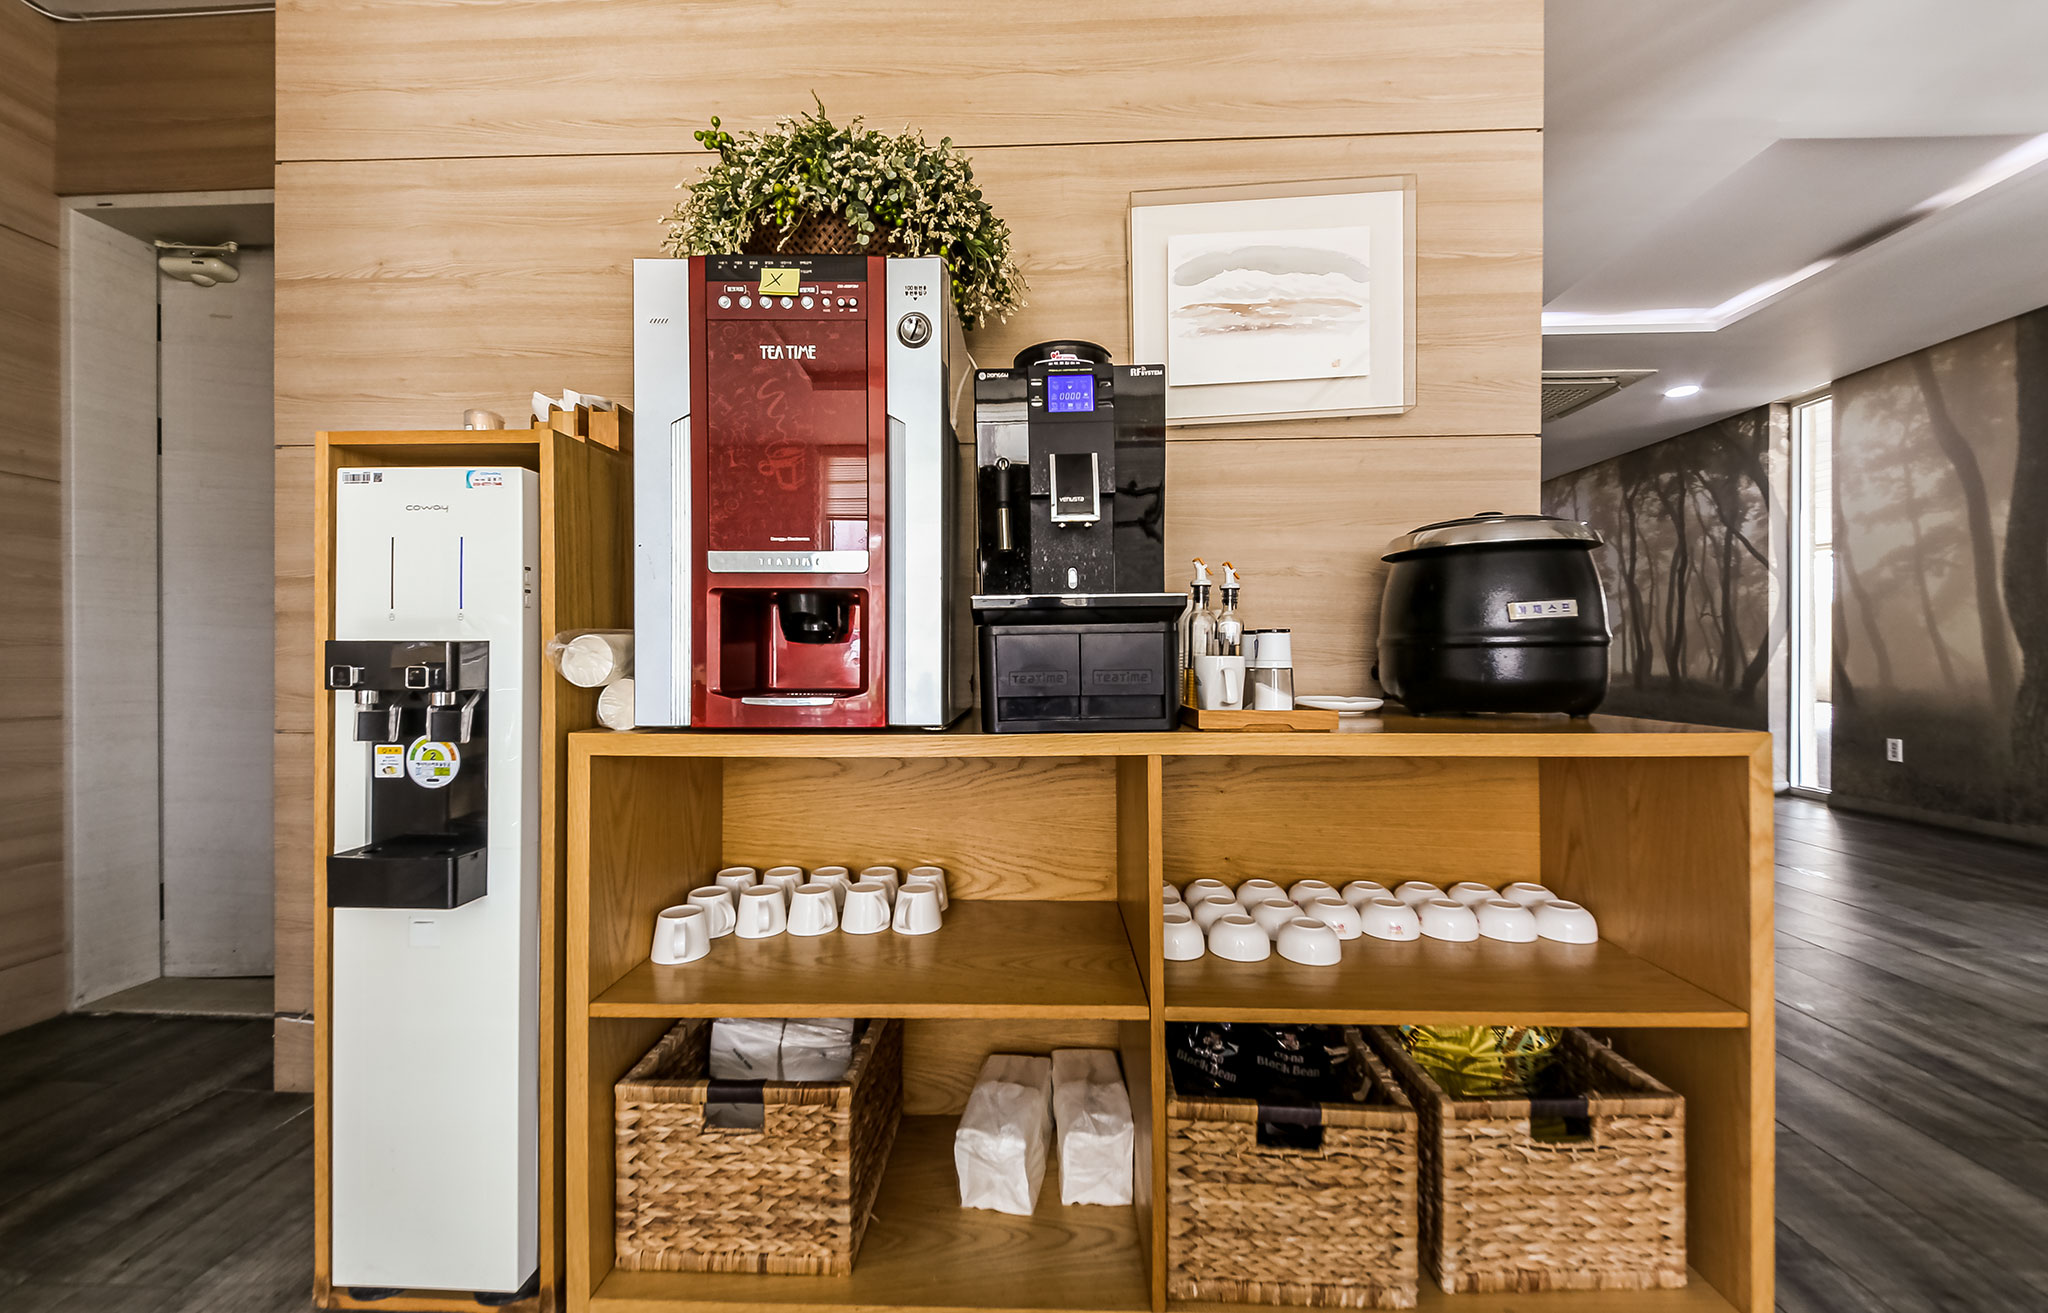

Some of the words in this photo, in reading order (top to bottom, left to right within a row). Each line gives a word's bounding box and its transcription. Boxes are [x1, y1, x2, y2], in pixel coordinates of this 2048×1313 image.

[759, 344, 784, 360] TEA
[785, 344, 817, 360] TIME
[430, 752, 437, 761] 2
[1256, 1055, 1290, 1075] Black
[1292, 1065, 1320, 1078] Bean
